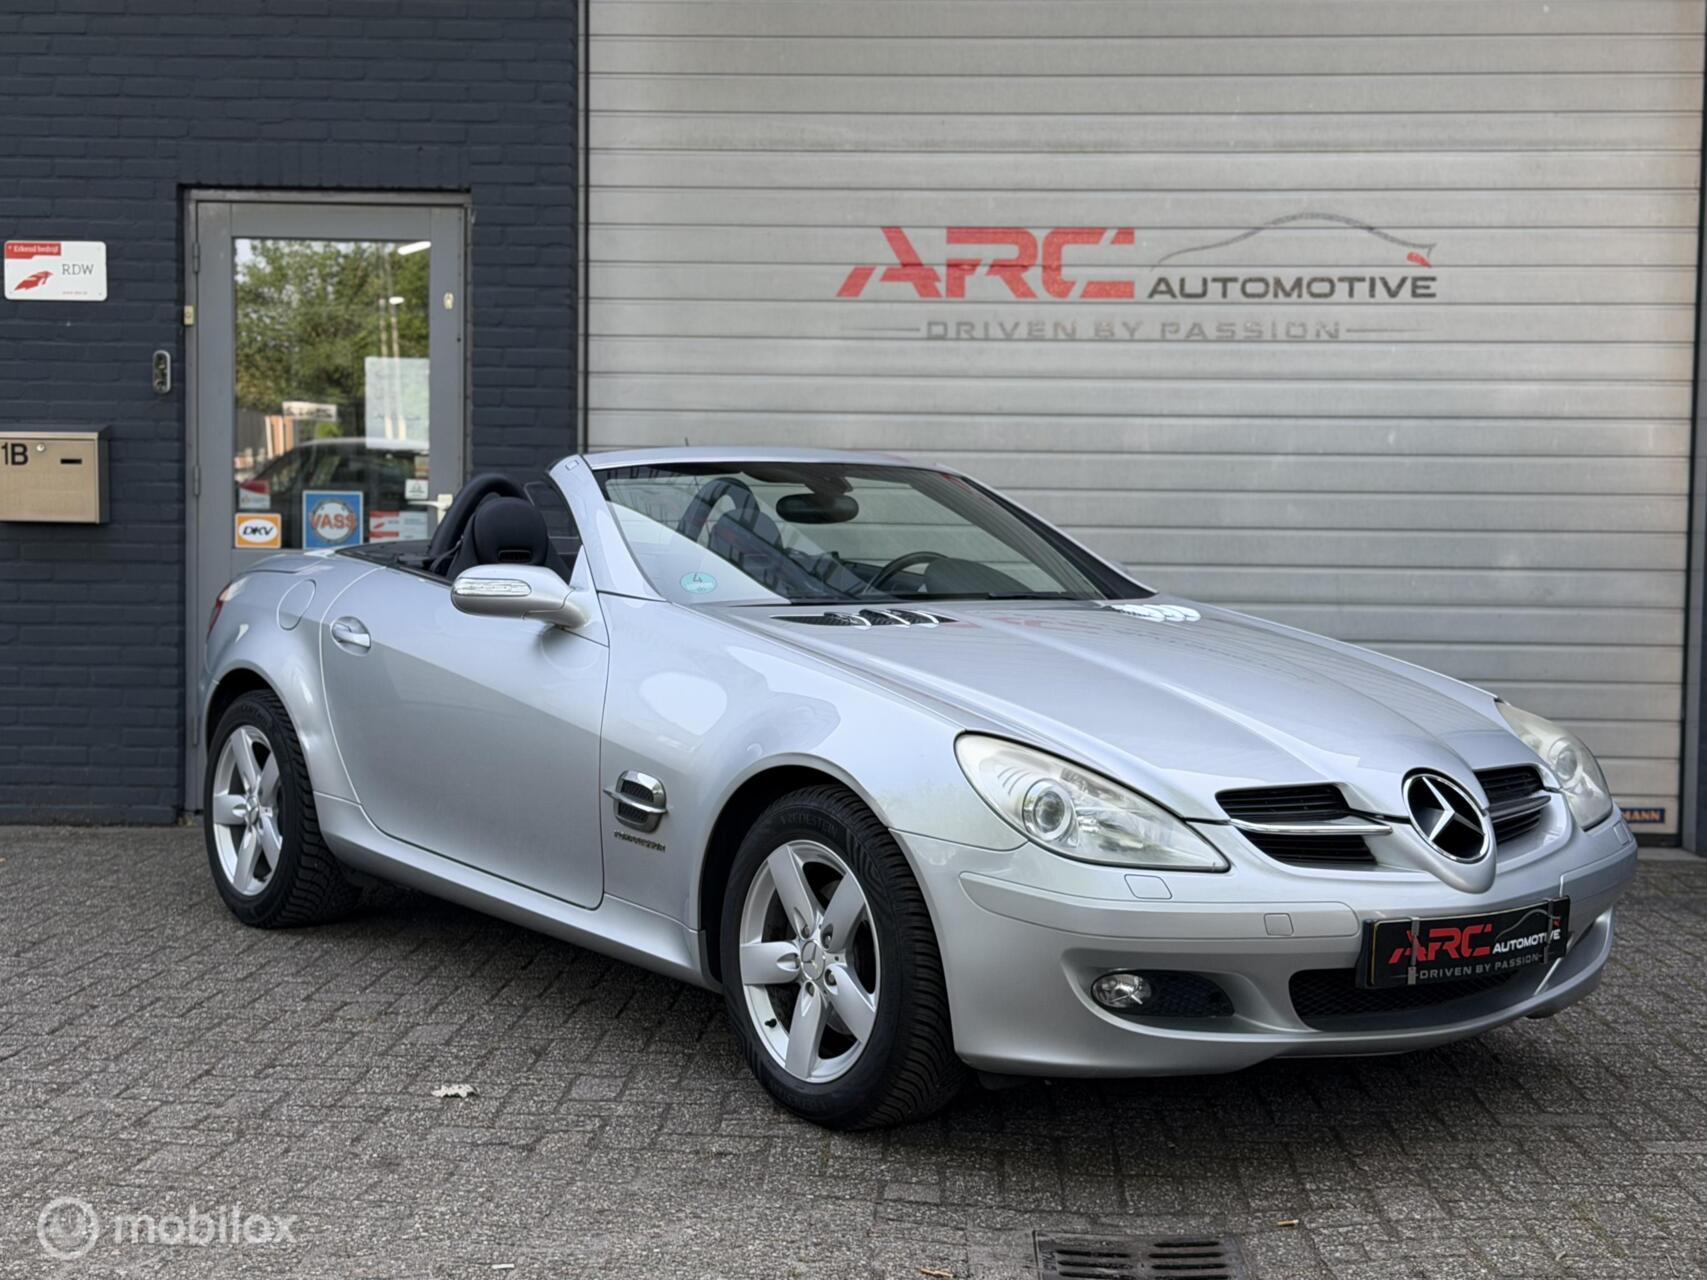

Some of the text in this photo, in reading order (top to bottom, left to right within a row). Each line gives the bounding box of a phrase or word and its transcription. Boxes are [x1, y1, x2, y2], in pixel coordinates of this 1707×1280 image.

[62, 264, 94, 275] RDW
[835, 226, 1437, 299] ARC AUTOMOTIVE
[926, 321, 1340, 340] DRIVEN BY PASSION
[1, 442, 29, 466] 1B
[243, 525, 274, 537] DKV
[308, 512, 357, 529] VASS
[1388, 924, 1560, 964] ARC AUTOMOTIVE
[1419, 953, 1539, 980] DRIVEN BY PASSION
